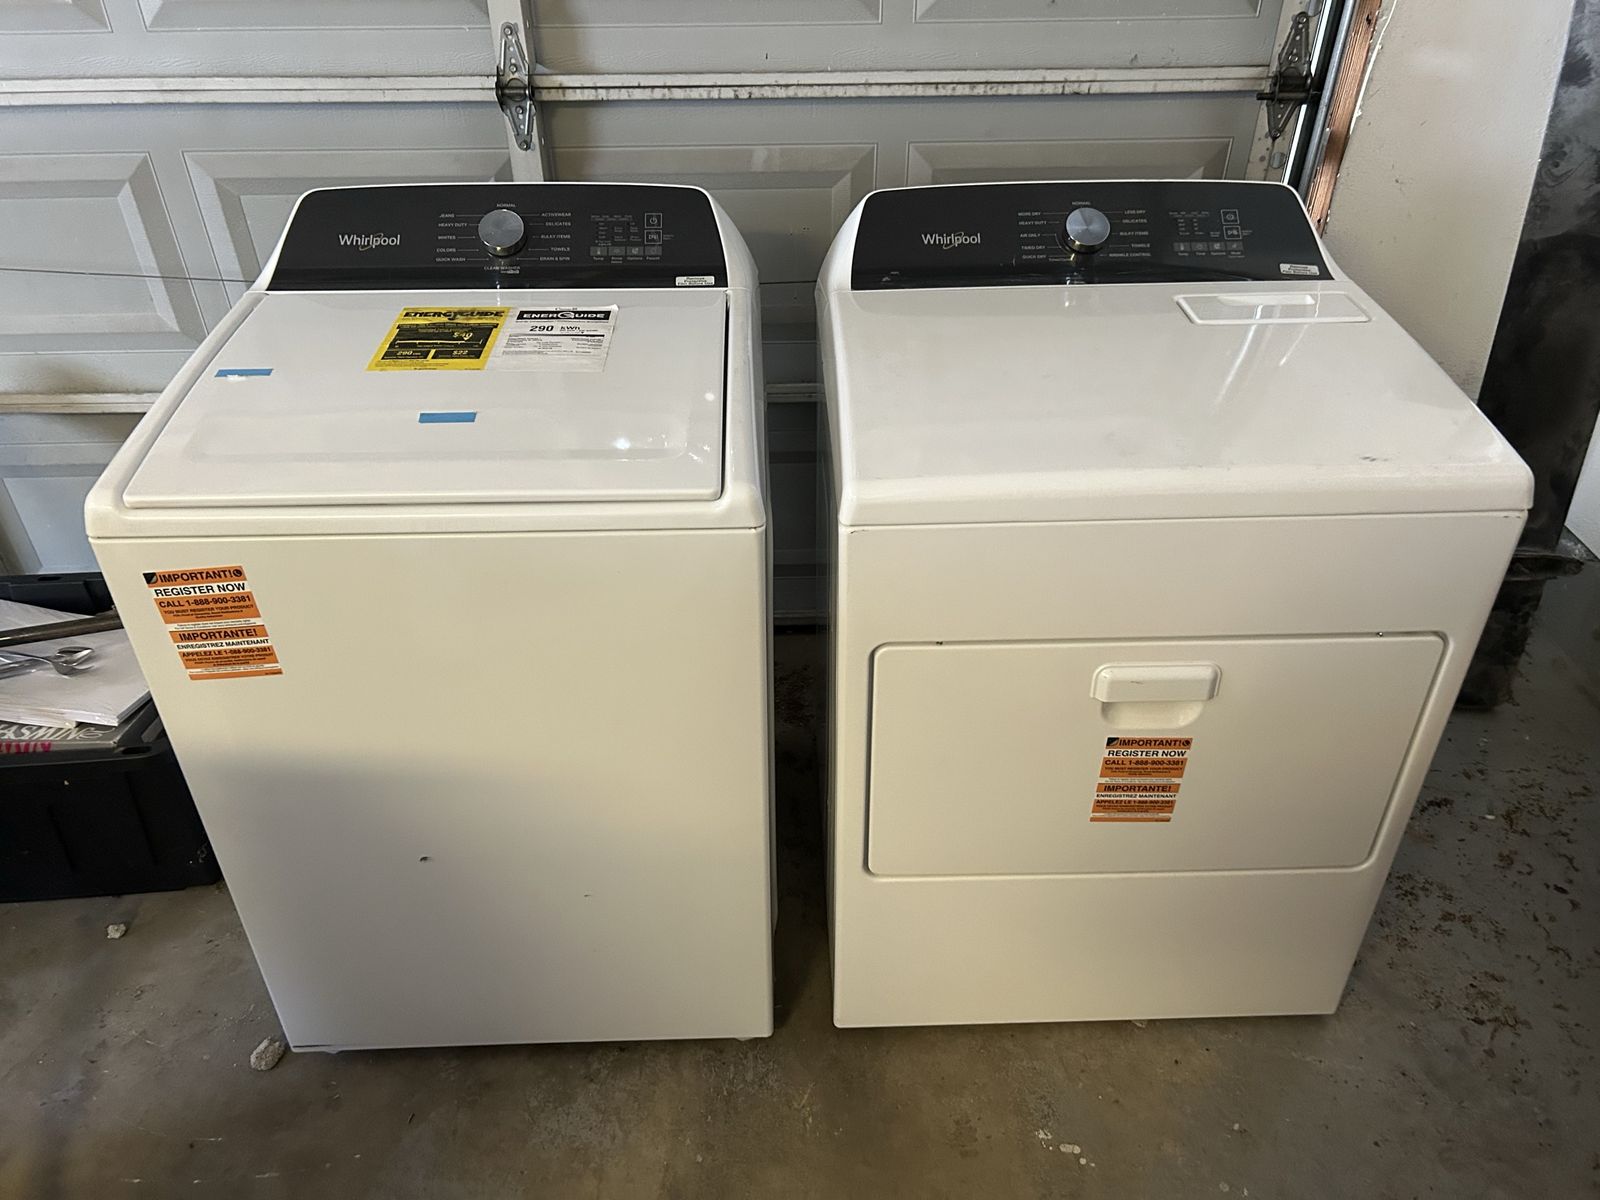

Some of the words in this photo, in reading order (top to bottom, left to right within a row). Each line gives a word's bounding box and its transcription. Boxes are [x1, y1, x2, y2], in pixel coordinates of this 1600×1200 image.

[338, 233, 401, 250] Whirlpool
[921, 232, 981, 249] Whirlpool
[158, 569, 233, 583] IMPORTANT!
[154, 584, 215, 597] REGISTER
[217, 582, 246, 592] NOW
[158, 599, 184, 608] CALL
[186, 595, 251, 607] 1-888-900-3381
[179, 628, 258, 642] IMPORTANTE!
[176, 642, 225, 650] ENREGISTREZ
[225, 639, 270, 647] MAINTENANT
[182, 650, 212, 658] APPELEZ
[1118, 739, 1181, 747] IMPORTANT!
[1107, 749, 1159, 757] REGISTER
